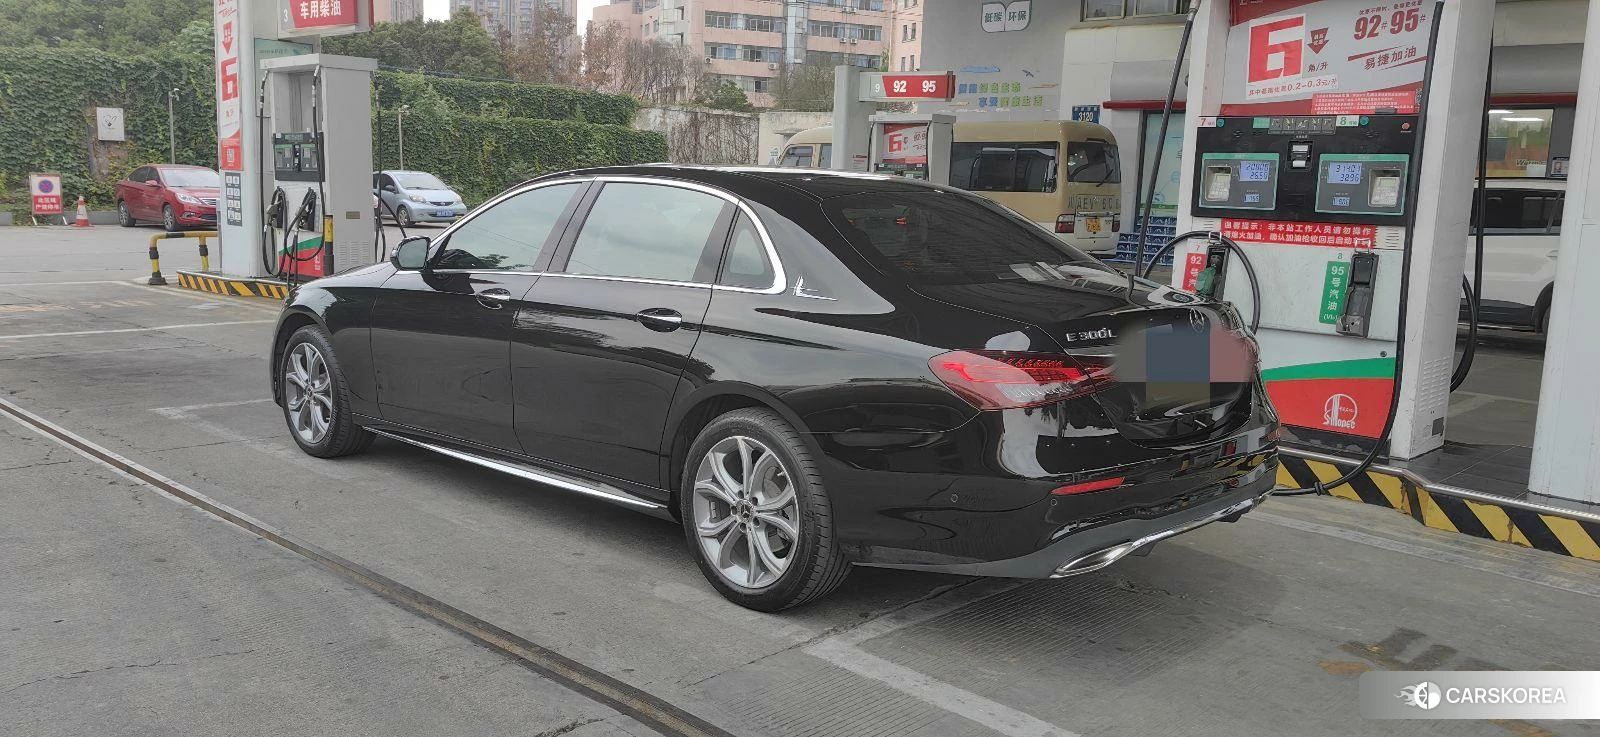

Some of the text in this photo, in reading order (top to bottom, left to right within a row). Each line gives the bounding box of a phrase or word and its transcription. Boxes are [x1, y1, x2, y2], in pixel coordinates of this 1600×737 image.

[283, 8, 289, 23] 3
[300, 0, 342, 20] 车用柴油
[985, 10, 1027, 23] 低碳 环保
[1248, 16, 1303, 83] 6
[1364, 45, 1417, 71] 易捷加油
[221, 56, 238, 102] 6
[875, 83, 880, 93] 9
[893, 80, 936, 93] 92 95
[1201, 117, 1207, 127] 7
[1340, 116, 1347, 126] 8
[888, 133, 903, 153] 6
[1066, 333, 1078, 342] E
